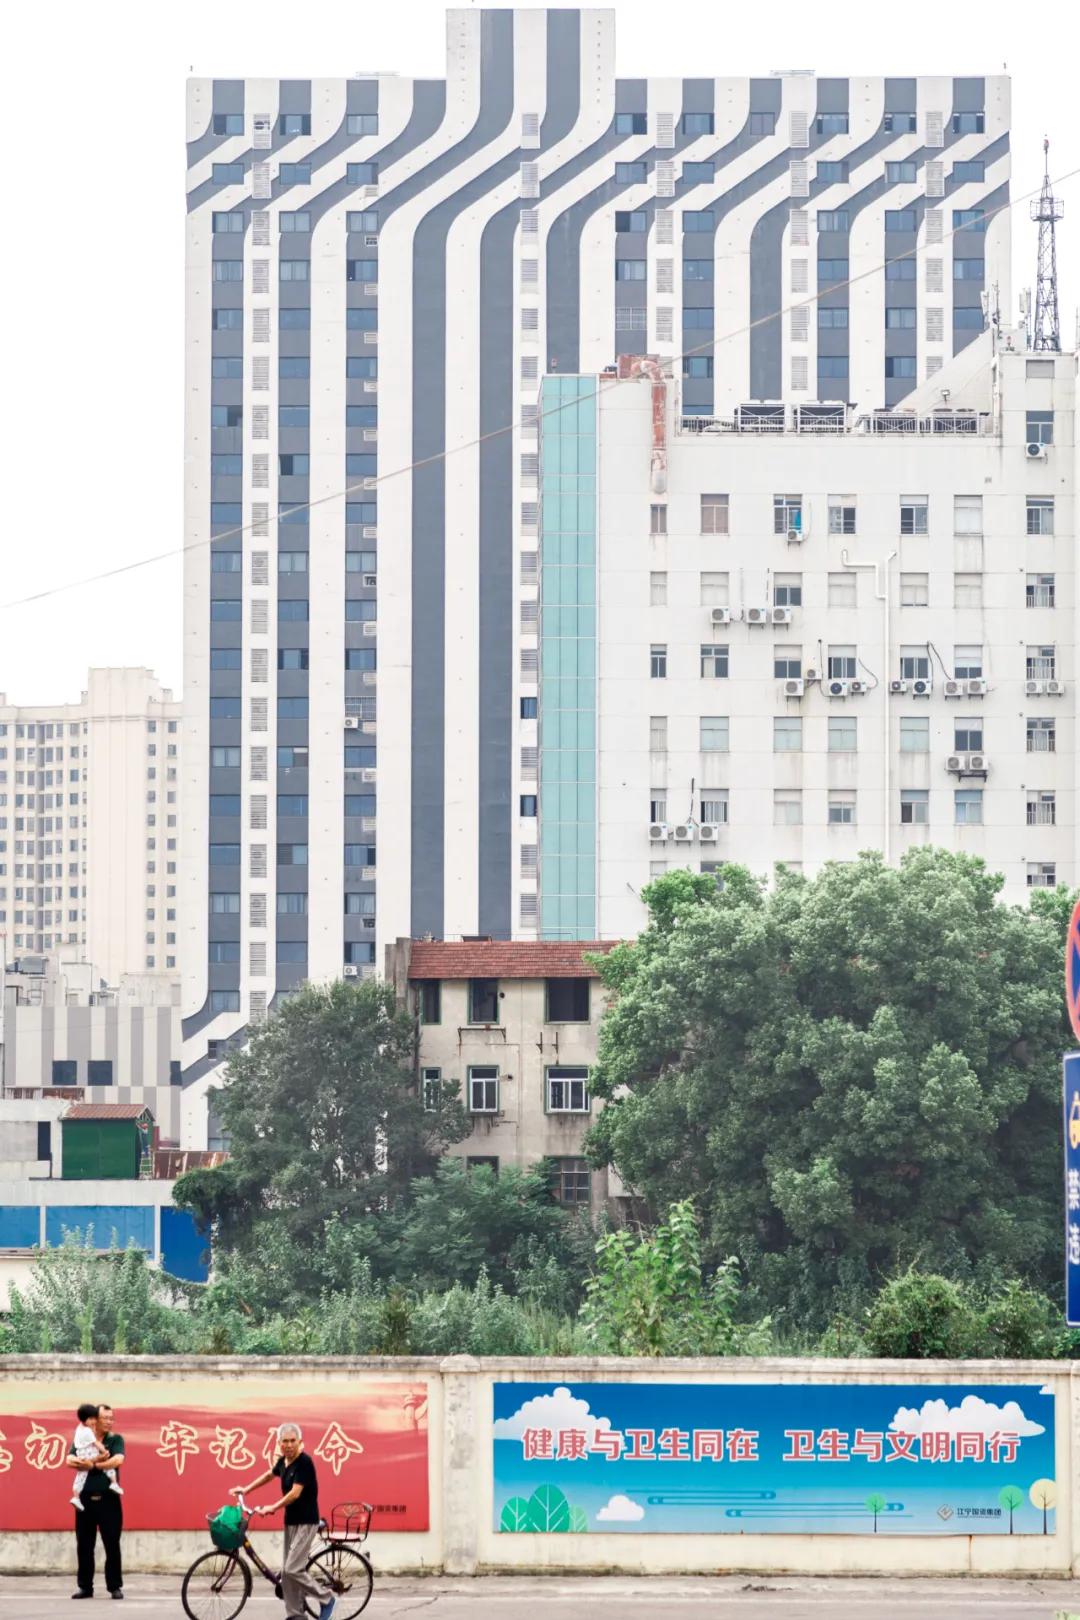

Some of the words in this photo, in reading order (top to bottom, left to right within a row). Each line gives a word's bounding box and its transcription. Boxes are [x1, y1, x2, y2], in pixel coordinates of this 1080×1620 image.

[0, 1420, 67, 1473] 初
[522, 1428, 760, 1463] 健康与卫生同在
[783, 1429, 1022, 1464] 卫生与文明同行
